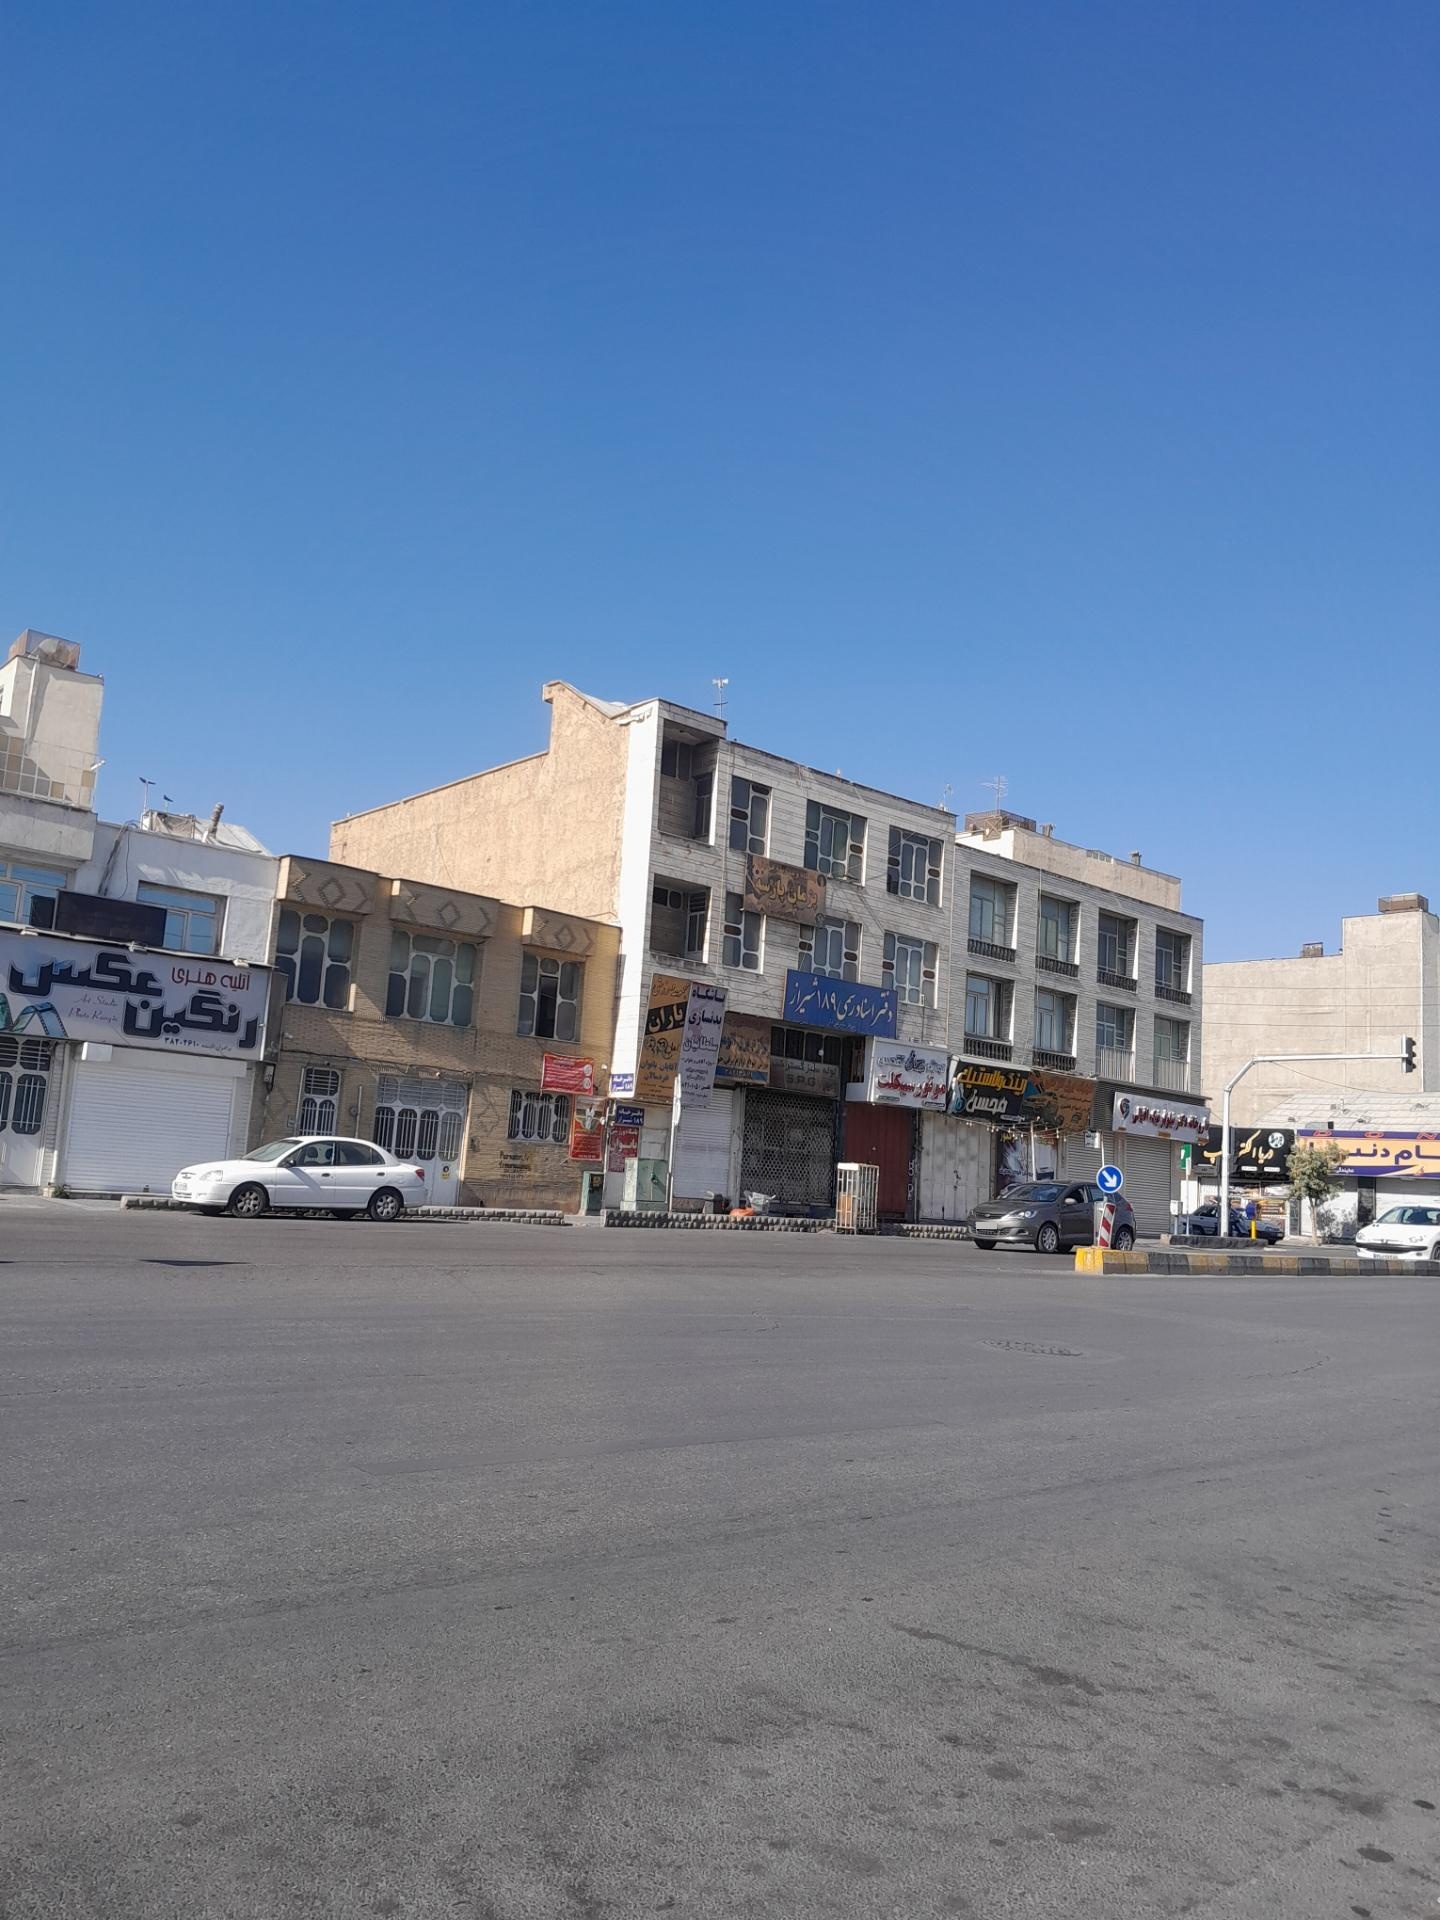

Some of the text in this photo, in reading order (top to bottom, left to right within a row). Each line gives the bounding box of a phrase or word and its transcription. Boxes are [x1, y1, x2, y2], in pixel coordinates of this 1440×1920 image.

[9, 951, 163, 997] عکس
[171, 966, 217, 987] هنری
[817, 989, 836, 1011] ۱۸۹
[123, 989, 259, 1048] رنگین
[966, 1088, 1008, 1115] محسن
